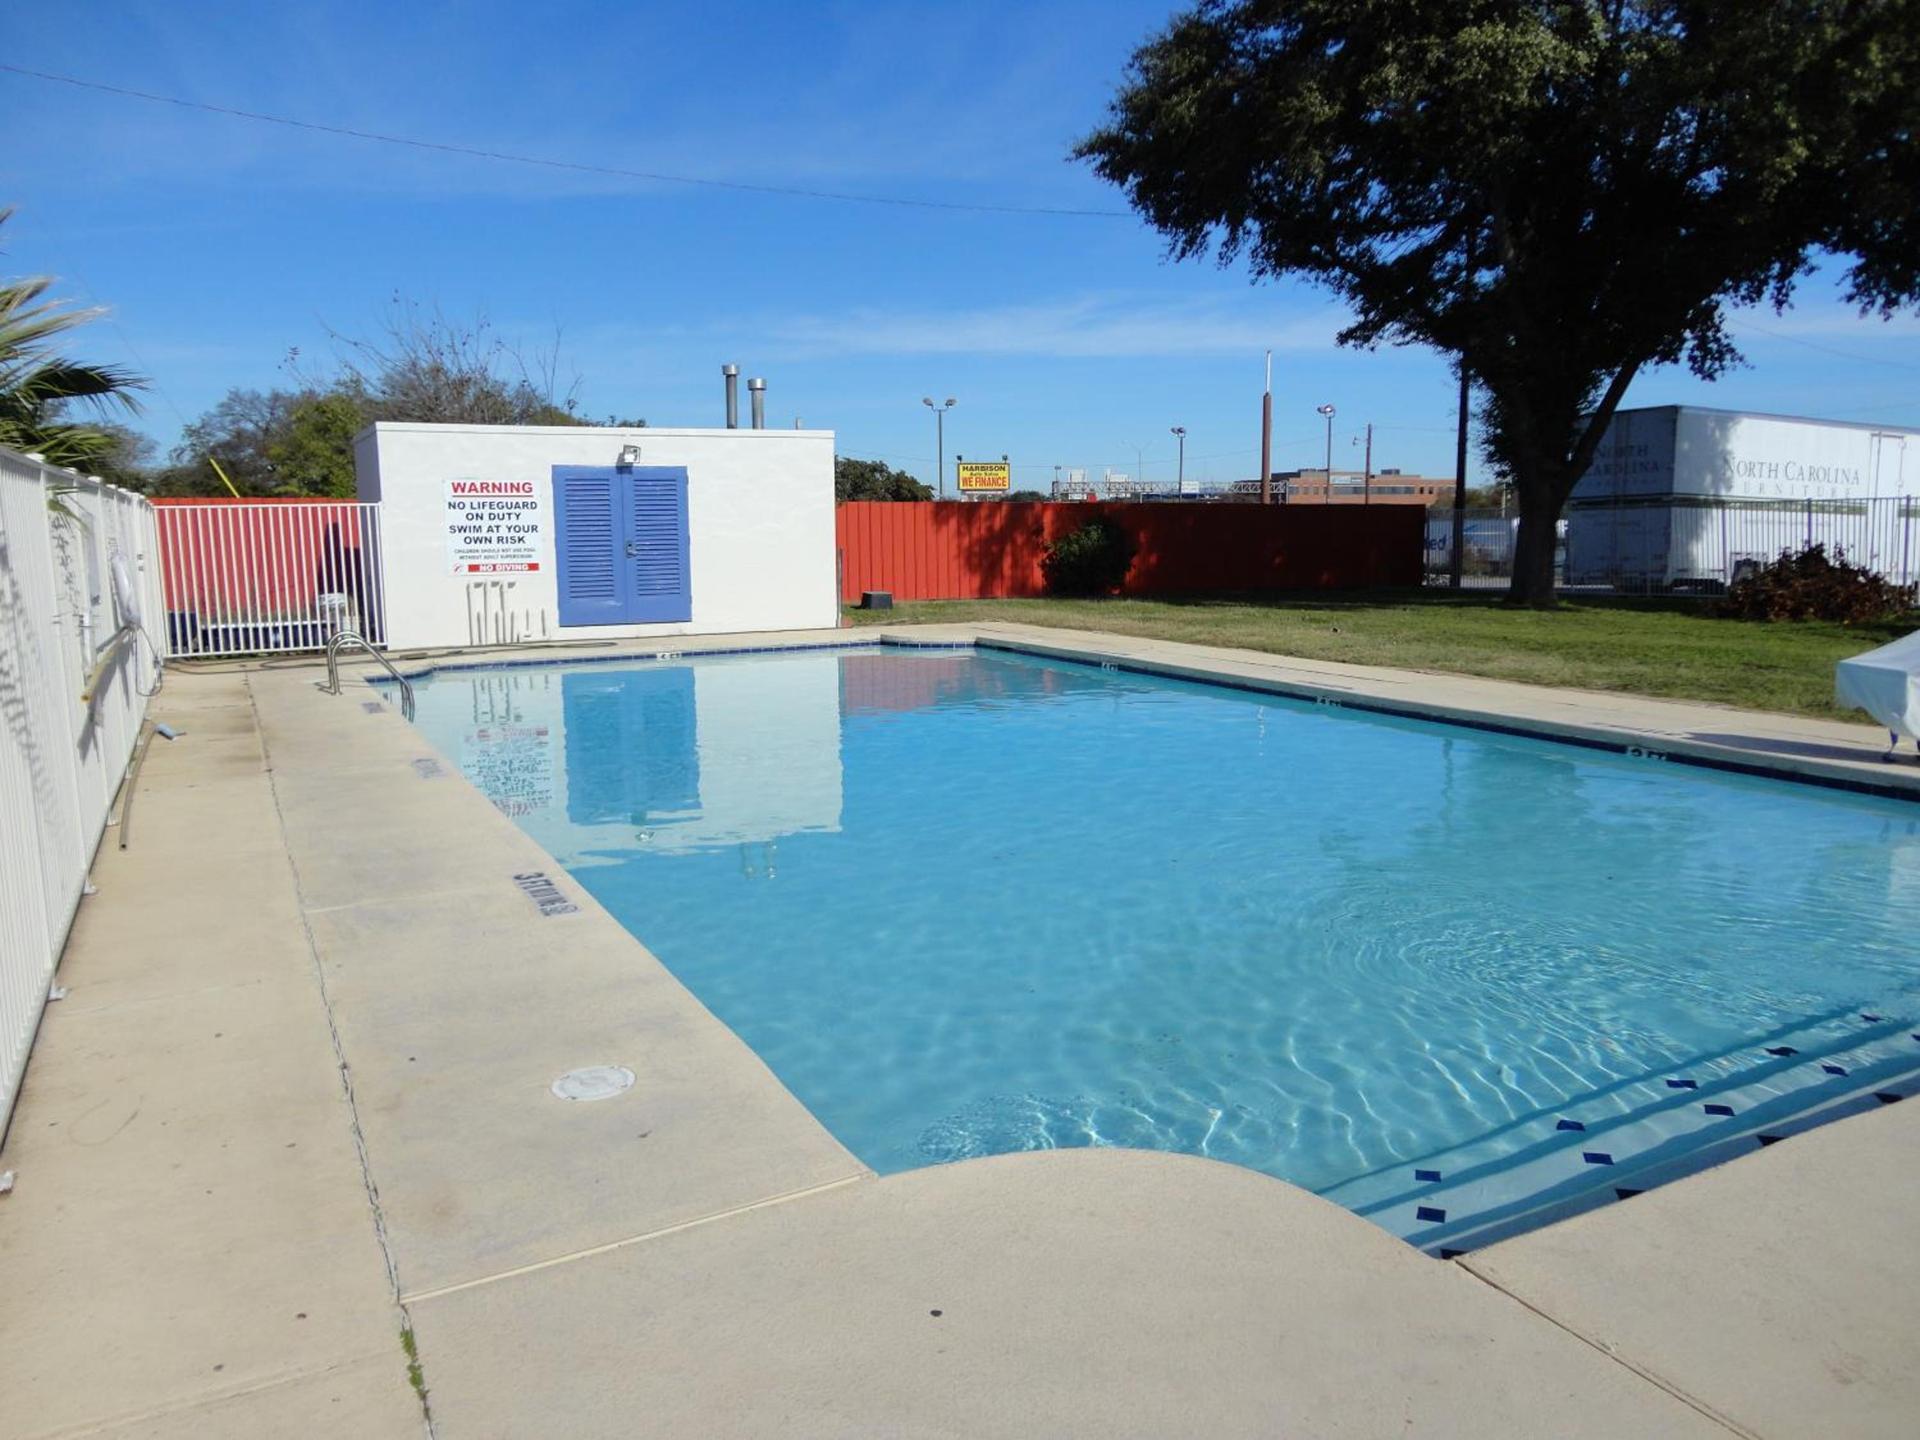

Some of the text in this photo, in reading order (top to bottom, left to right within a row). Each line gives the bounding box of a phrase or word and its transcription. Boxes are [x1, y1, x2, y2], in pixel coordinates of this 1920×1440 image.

[1723, 455, 1860, 485] NORTH CAROLINA
[962, 476, 1007, 487] WE FINANCE
[451, 482, 533, 493] WARNING
[448, 501, 538, 510] NO LIFEGUARD
[465, 512, 521, 521] ON DUTY
[449, 524, 538, 533] SWIM AT YOUR
[463, 536, 526, 544] OWN RISK
[479, 563, 529, 572] NO DIVING
